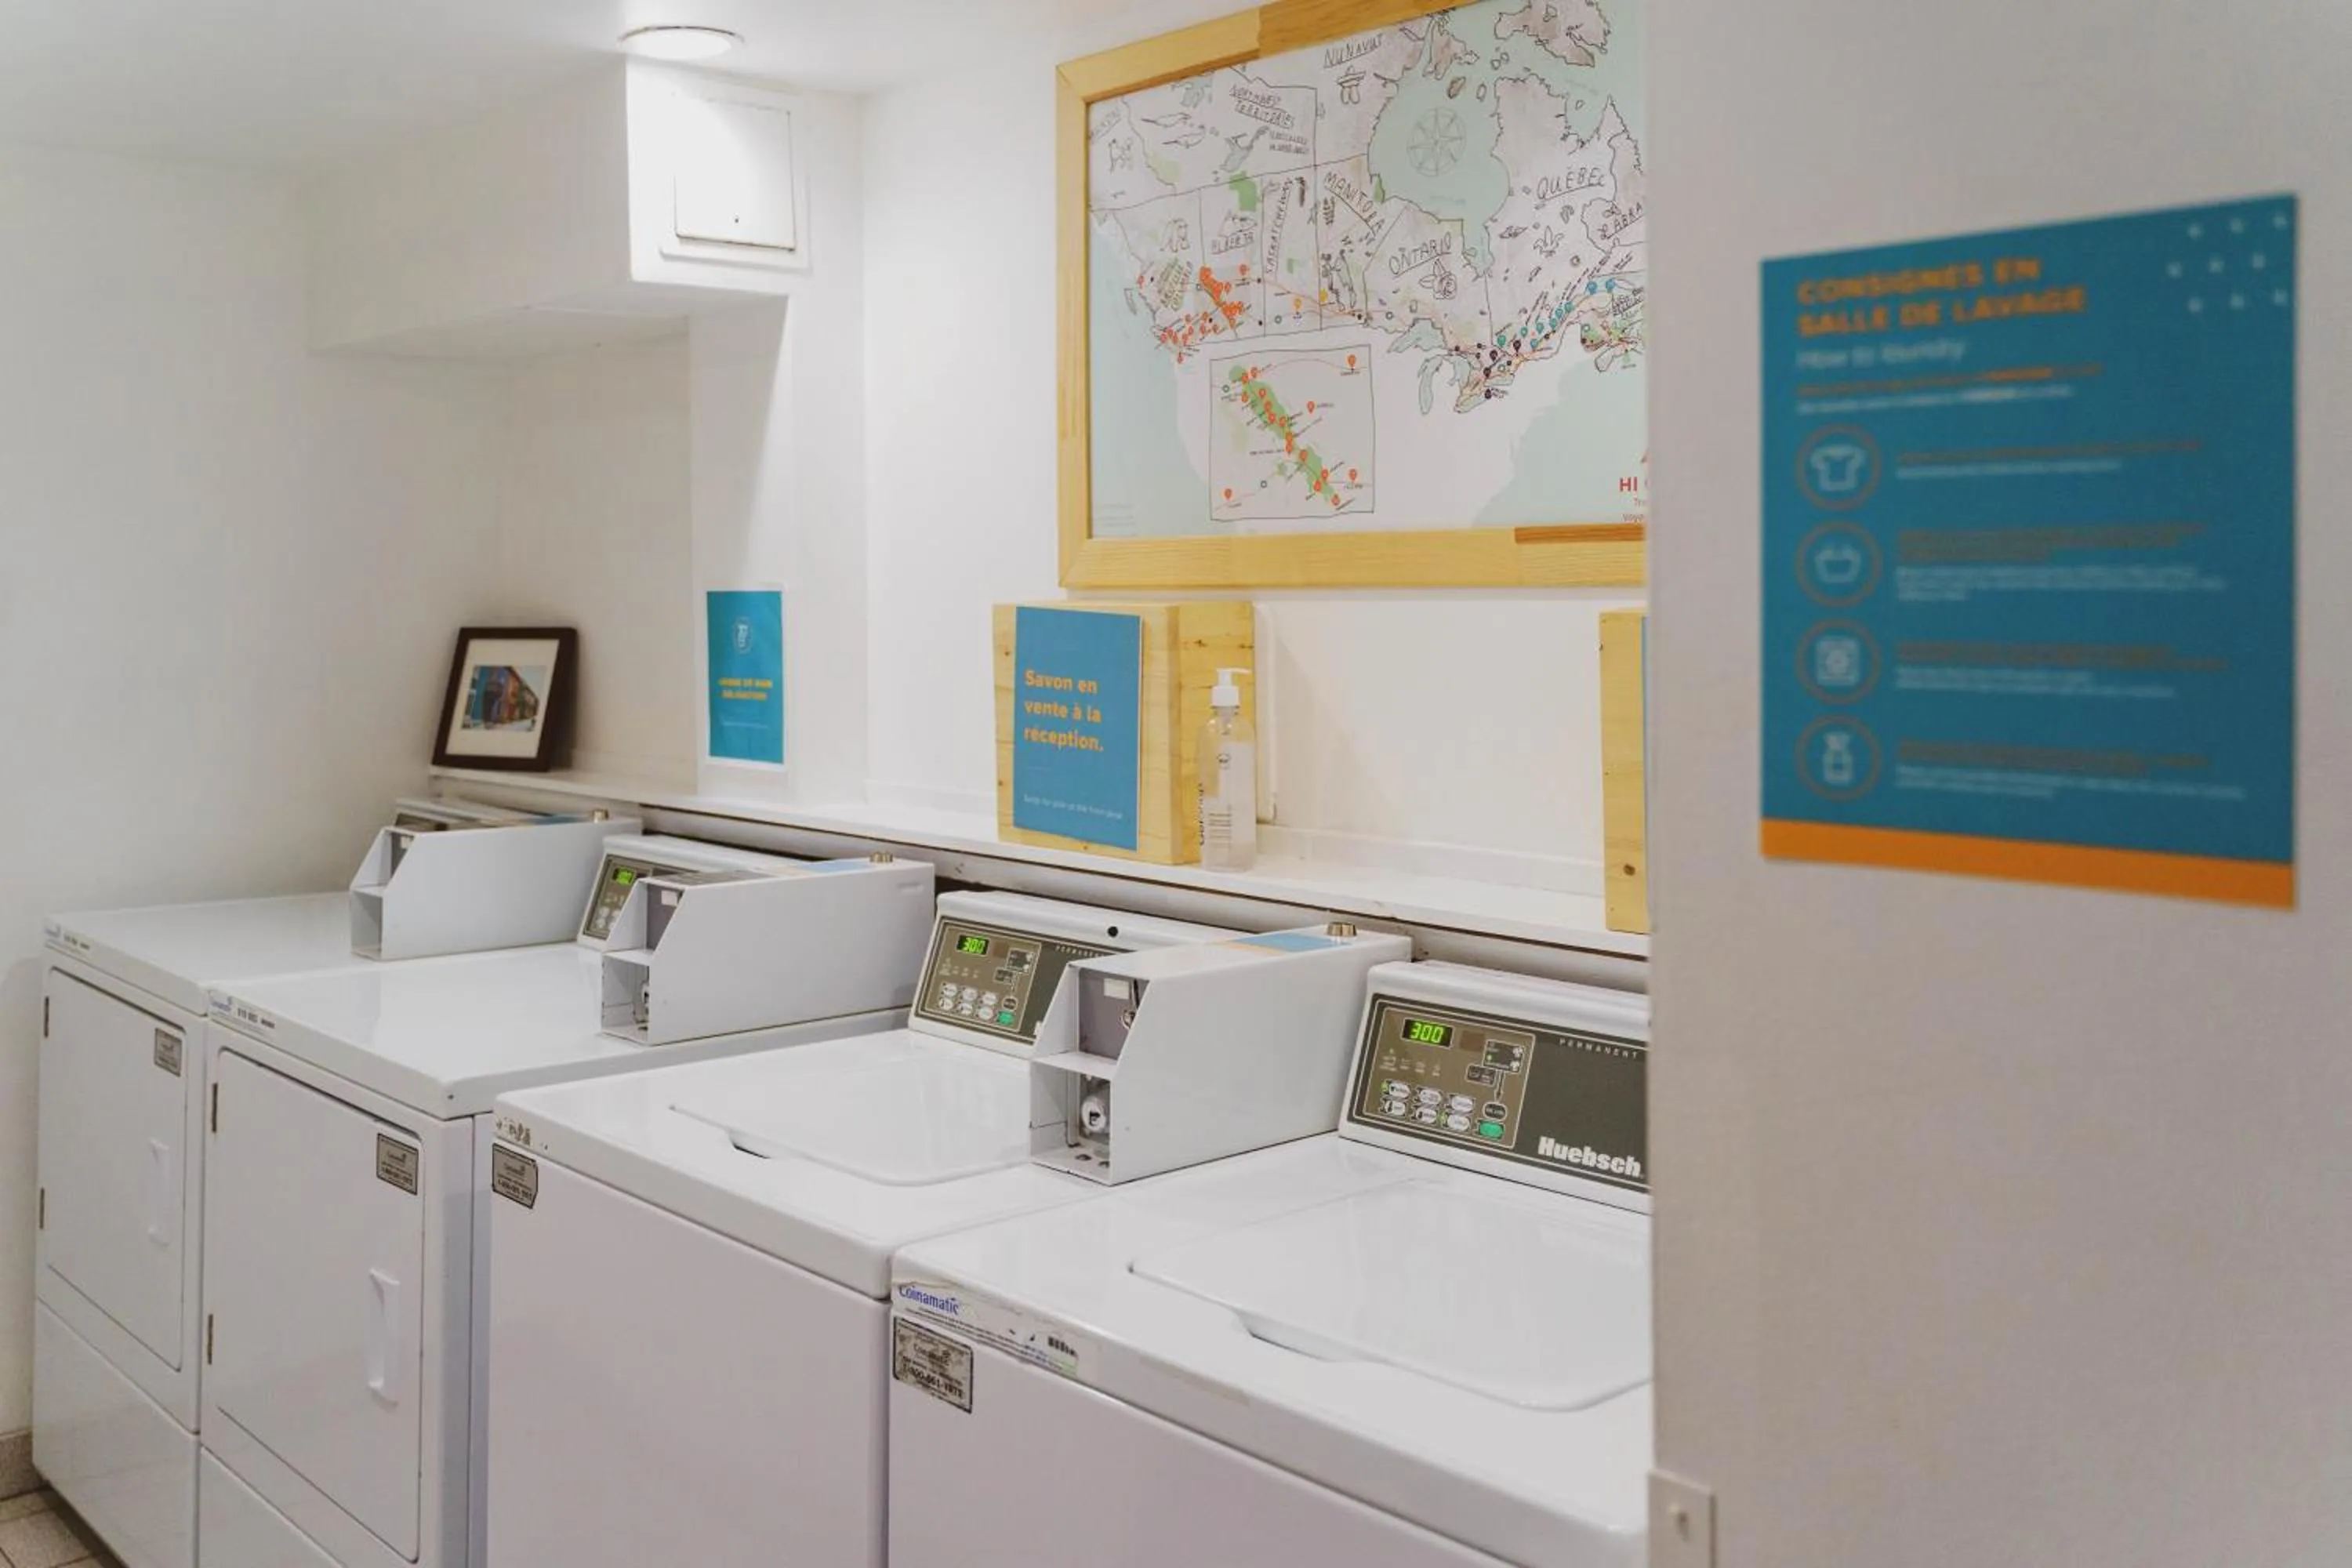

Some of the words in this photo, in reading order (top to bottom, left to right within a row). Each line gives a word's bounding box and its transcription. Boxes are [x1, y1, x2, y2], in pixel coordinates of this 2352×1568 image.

[1994, 257, 2041, 285] EN
[1798, 304, 1888, 337] SALLE
[1899, 299, 1940, 329] DE
[1951, 284, 2085, 323] LAVAGE
[1619, 476, 1638, 492] HI
[1024, 669, 1073, 691] Savon
[1078, 680, 1098, 695] en
[1024, 700, 1068, 720] vente
[1073, 702, 1082, 720] à
[1087, 704, 1102, 723] la
[1024, 724, 1104, 752] réception.
[963, 935, 986, 954] 300
[1410, 1022, 1443, 1044] 300
[1559, 1036, 1638, 1059] PERMANENT
[1537, 1135, 1642, 1178] Huebsch
[898, 1284, 960, 1316] Coinamatic
